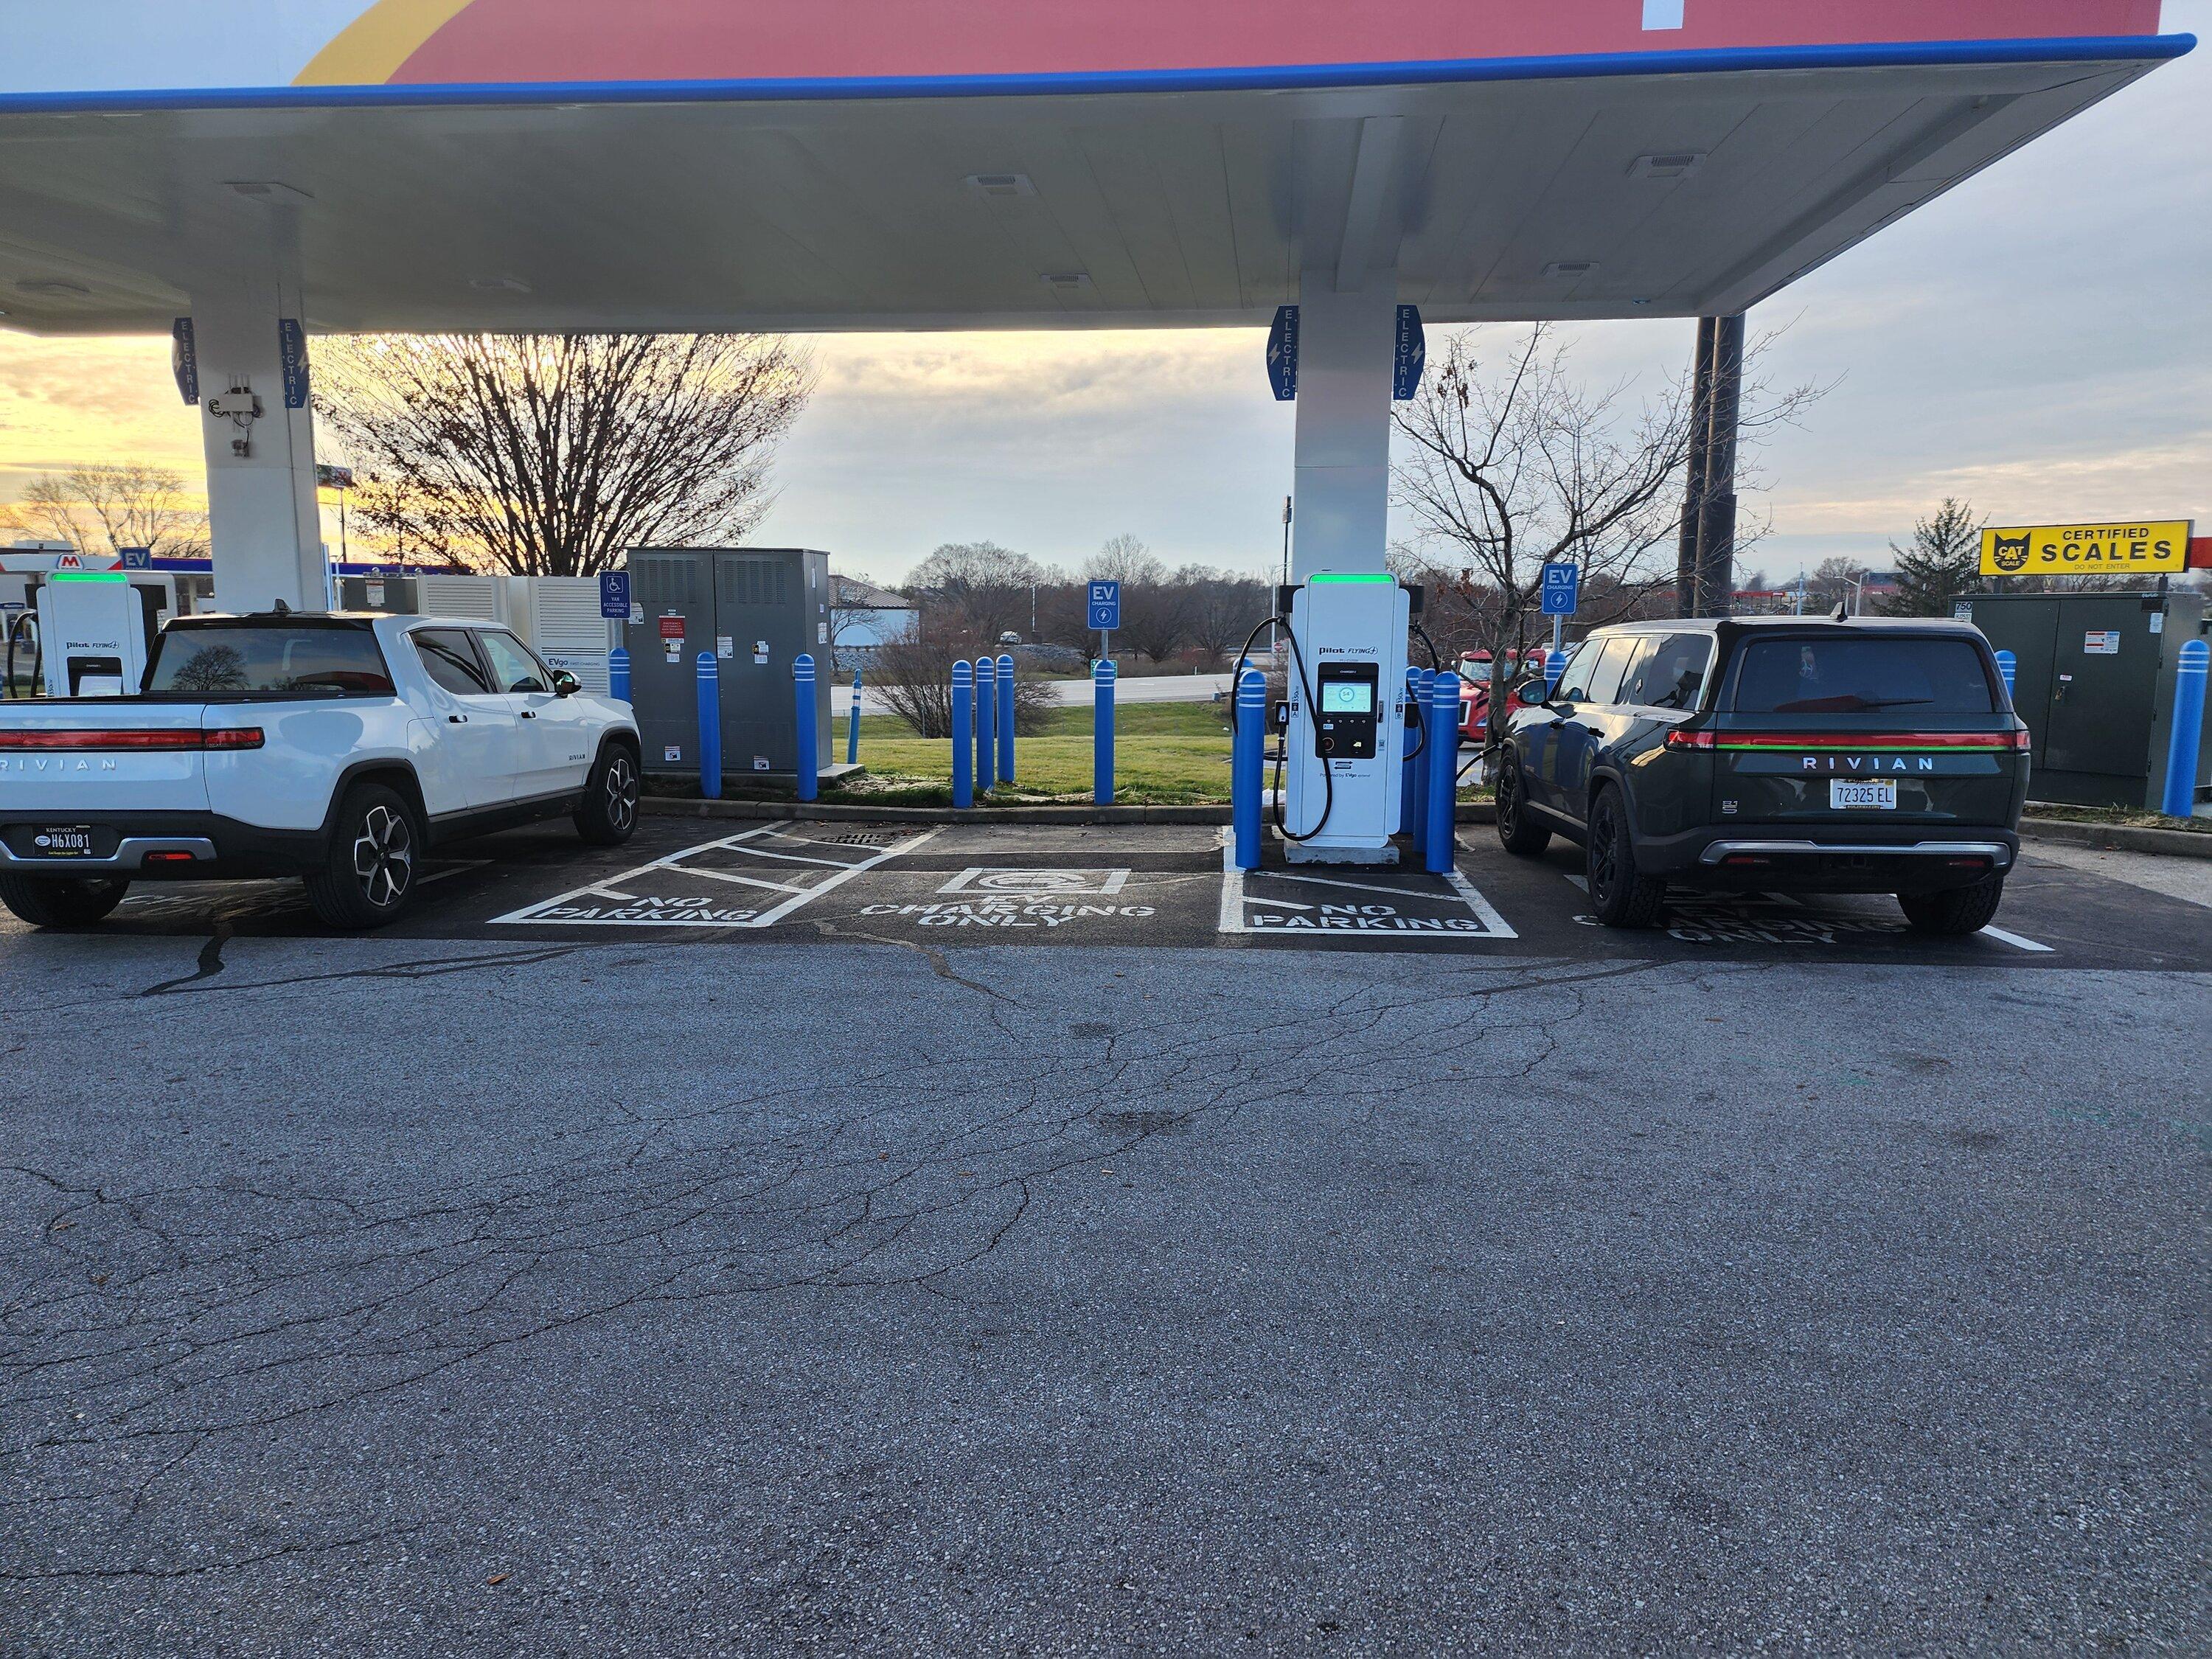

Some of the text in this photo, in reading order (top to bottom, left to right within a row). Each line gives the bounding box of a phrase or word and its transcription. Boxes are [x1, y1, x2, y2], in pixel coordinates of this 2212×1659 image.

[1281, 310, 1293, 397] ELECTRIC
[1398, 309, 1410, 397] ELECTRIC
[181, 321, 195, 403] ELECTRIC
[285, 322, 298, 405] ELECTRIC
[2062, 528, 2149, 540] CERTIFIED
[1998, 546, 2025, 560] CAT
[2041, 540, 2171, 562] SCALES
[125, 553, 147, 566] EV
[1549, 569, 1573, 583] EV
[1093, 586, 1115, 600] EV
[1956, 602, 1972, 611] 750
[549, 658, 568, 667] EVgo
[0, 759, 116, 771] RIVIAN
[1803, 757, 1933, 770] RIVIAN
[1837, 787, 1892, 802] 72325 EL
[52, 834, 89, 848] H6X081
[630, 897, 714, 908] NO
[981, 895, 1054, 905] EV
[535, 907, 759, 922] PARKING
[860, 904, 1157, 917] CHARGING
[1321, 903, 1397, 916] NO
[917, 914, 1079, 928] ONLY
[1253, 914, 1479, 931] PARKING
[1667, 928, 1837, 944] ONLY
